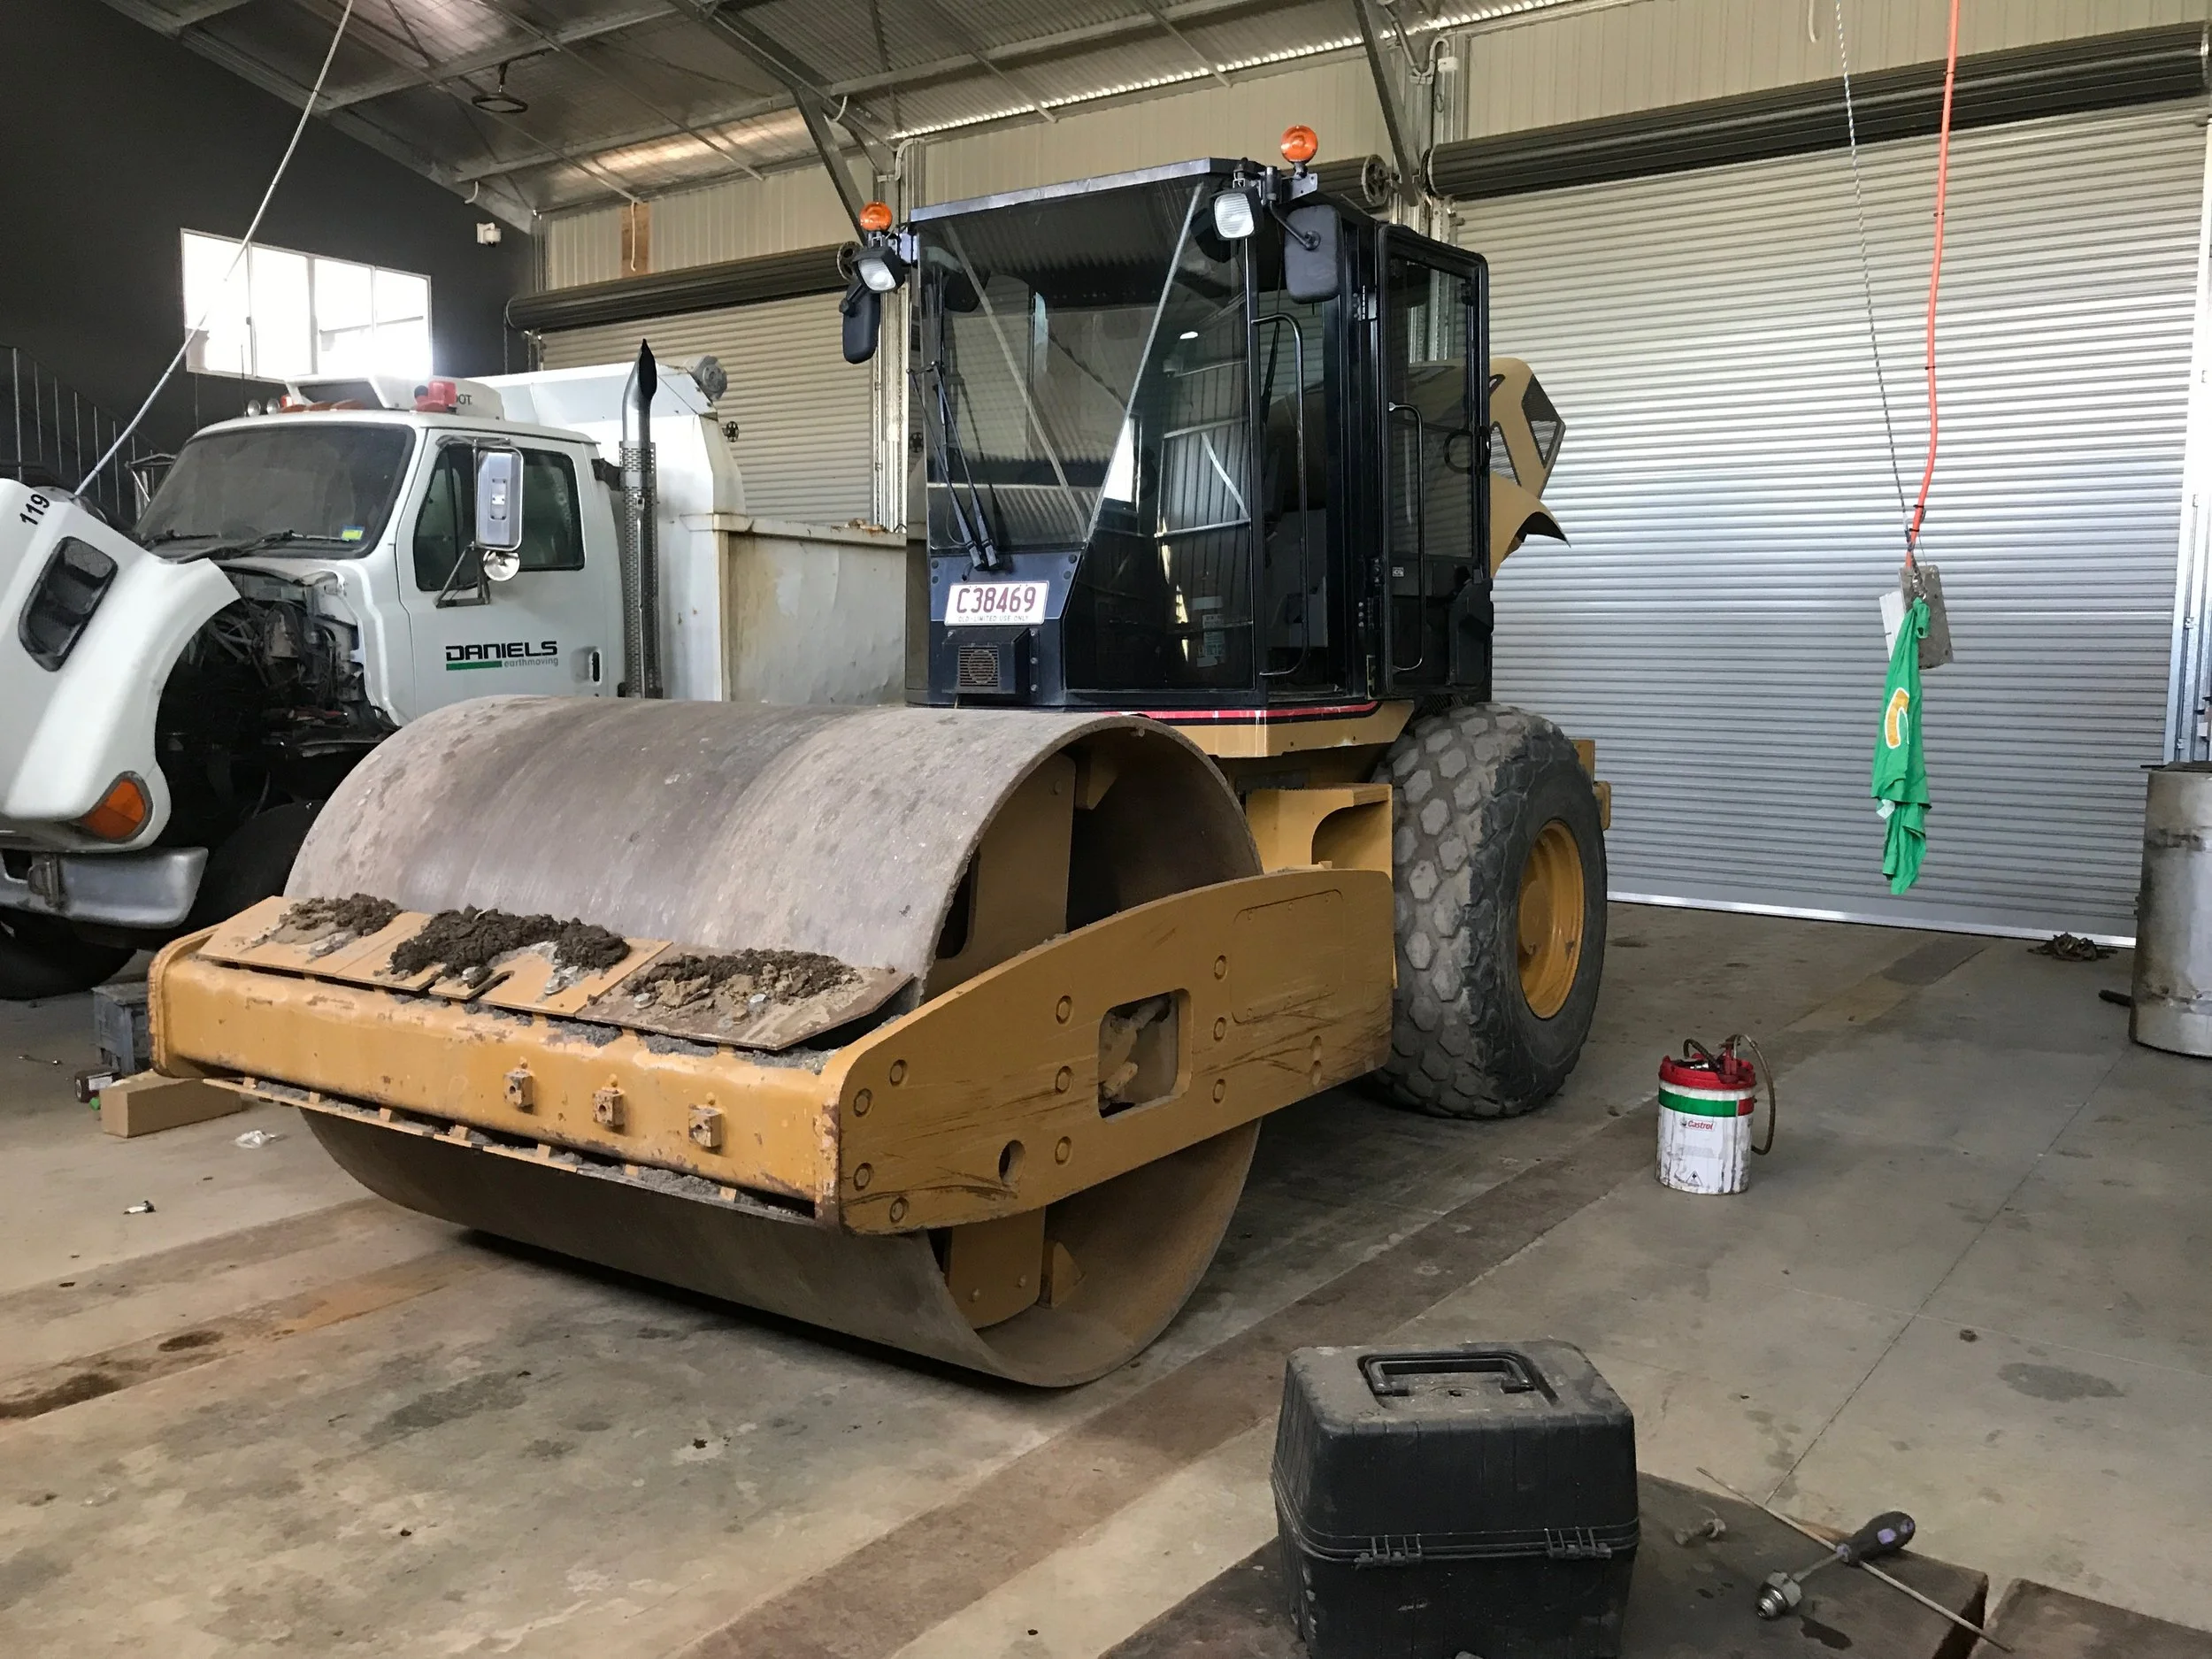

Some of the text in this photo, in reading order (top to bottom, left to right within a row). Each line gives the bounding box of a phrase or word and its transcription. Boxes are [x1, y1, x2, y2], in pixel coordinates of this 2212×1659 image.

[19, 494, 50, 525] 119
[956, 587, 1036, 613] C38469
[445, 641, 557, 661] DANIELS
[503, 657, 559, 667] earthmoving
[1687, 1120, 1714, 1130] Castrol
